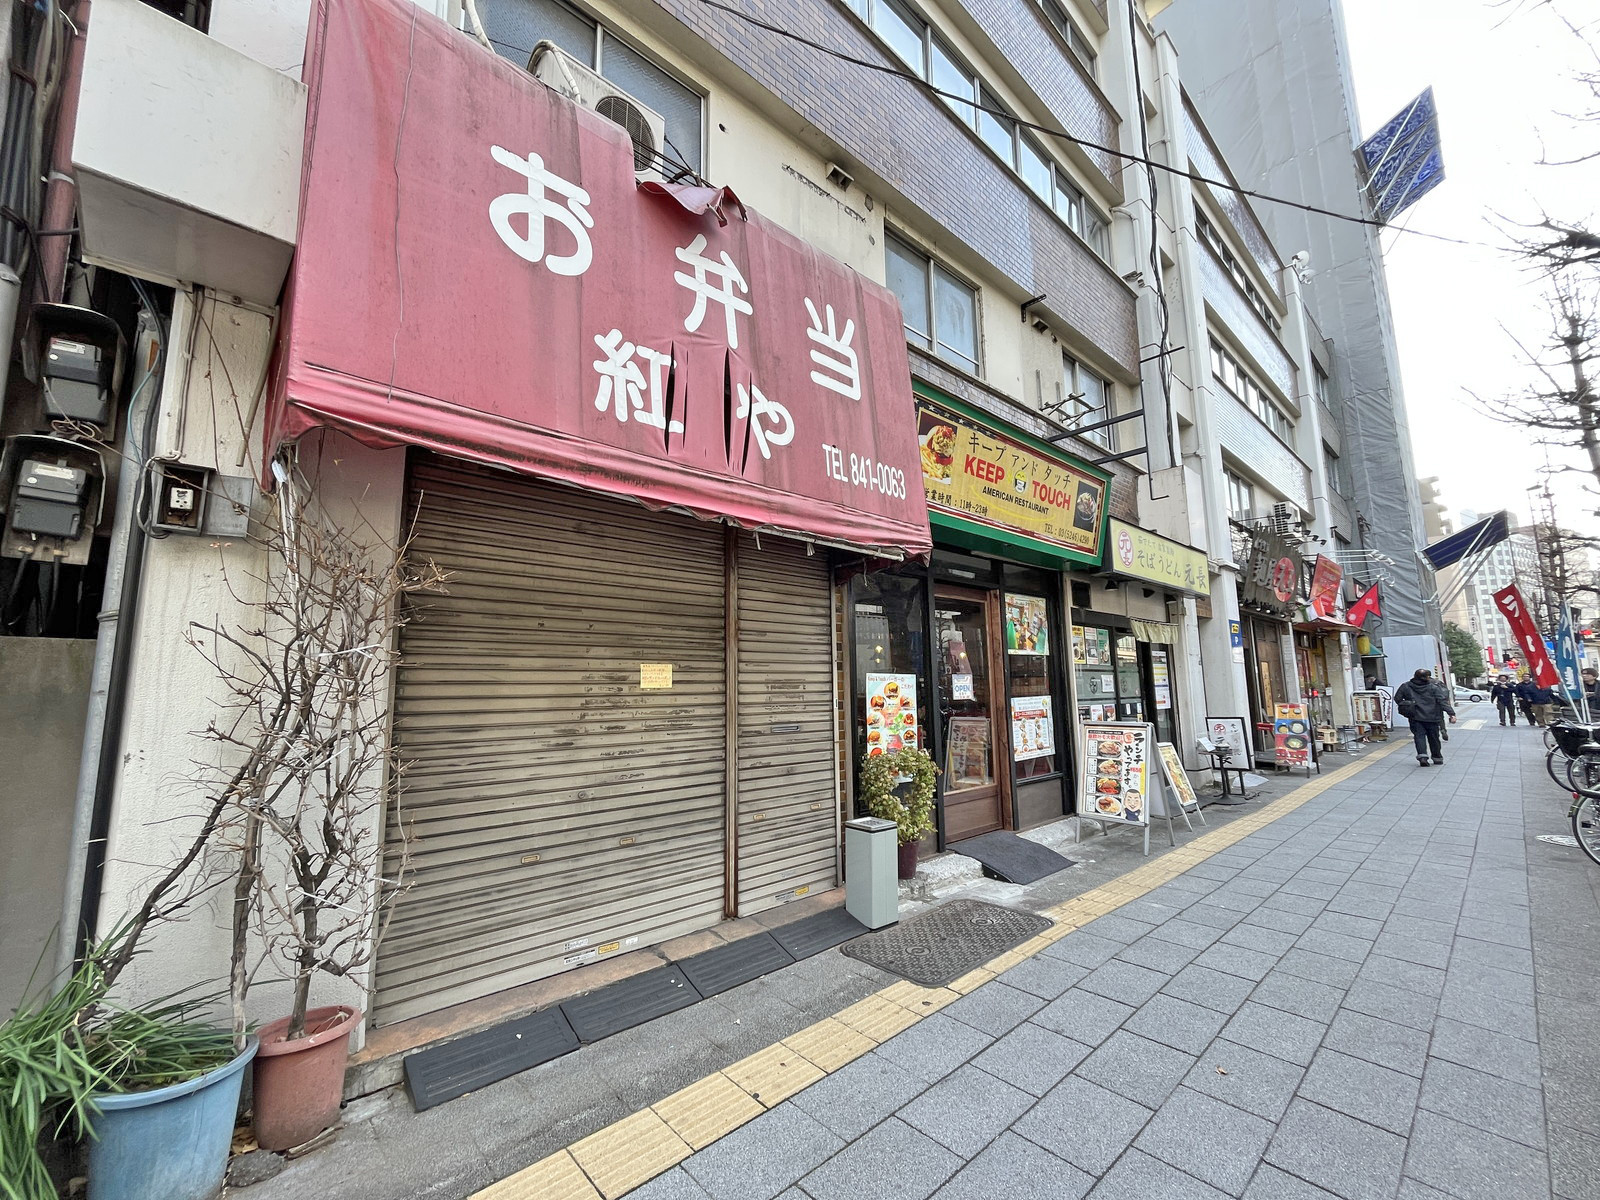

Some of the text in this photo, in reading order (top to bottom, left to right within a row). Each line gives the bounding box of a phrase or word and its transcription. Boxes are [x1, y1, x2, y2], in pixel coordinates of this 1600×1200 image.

[489, 144, 862, 400] お弁当
[593, 328, 795, 460] 紅や
[822, 443, 907, 501] TEL 841-0063
[963, 453, 1072, 511] KEEP TOUCH
[968, 432, 1007, 462] キープ
[1011, 454, 1039, 476] アンド
[1044, 465, 1071, 489] タッチ
[982, 485, 1014, 504] AMERICAN
[1014, 496, 1049, 515] RESTAURANT
[1137, 549, 1156, 571] そば
[1158, 555, 1181, 578] うどん
[954, 684, 971, 692] OPEN
[1133, 732, 1145, 765] ランチ
